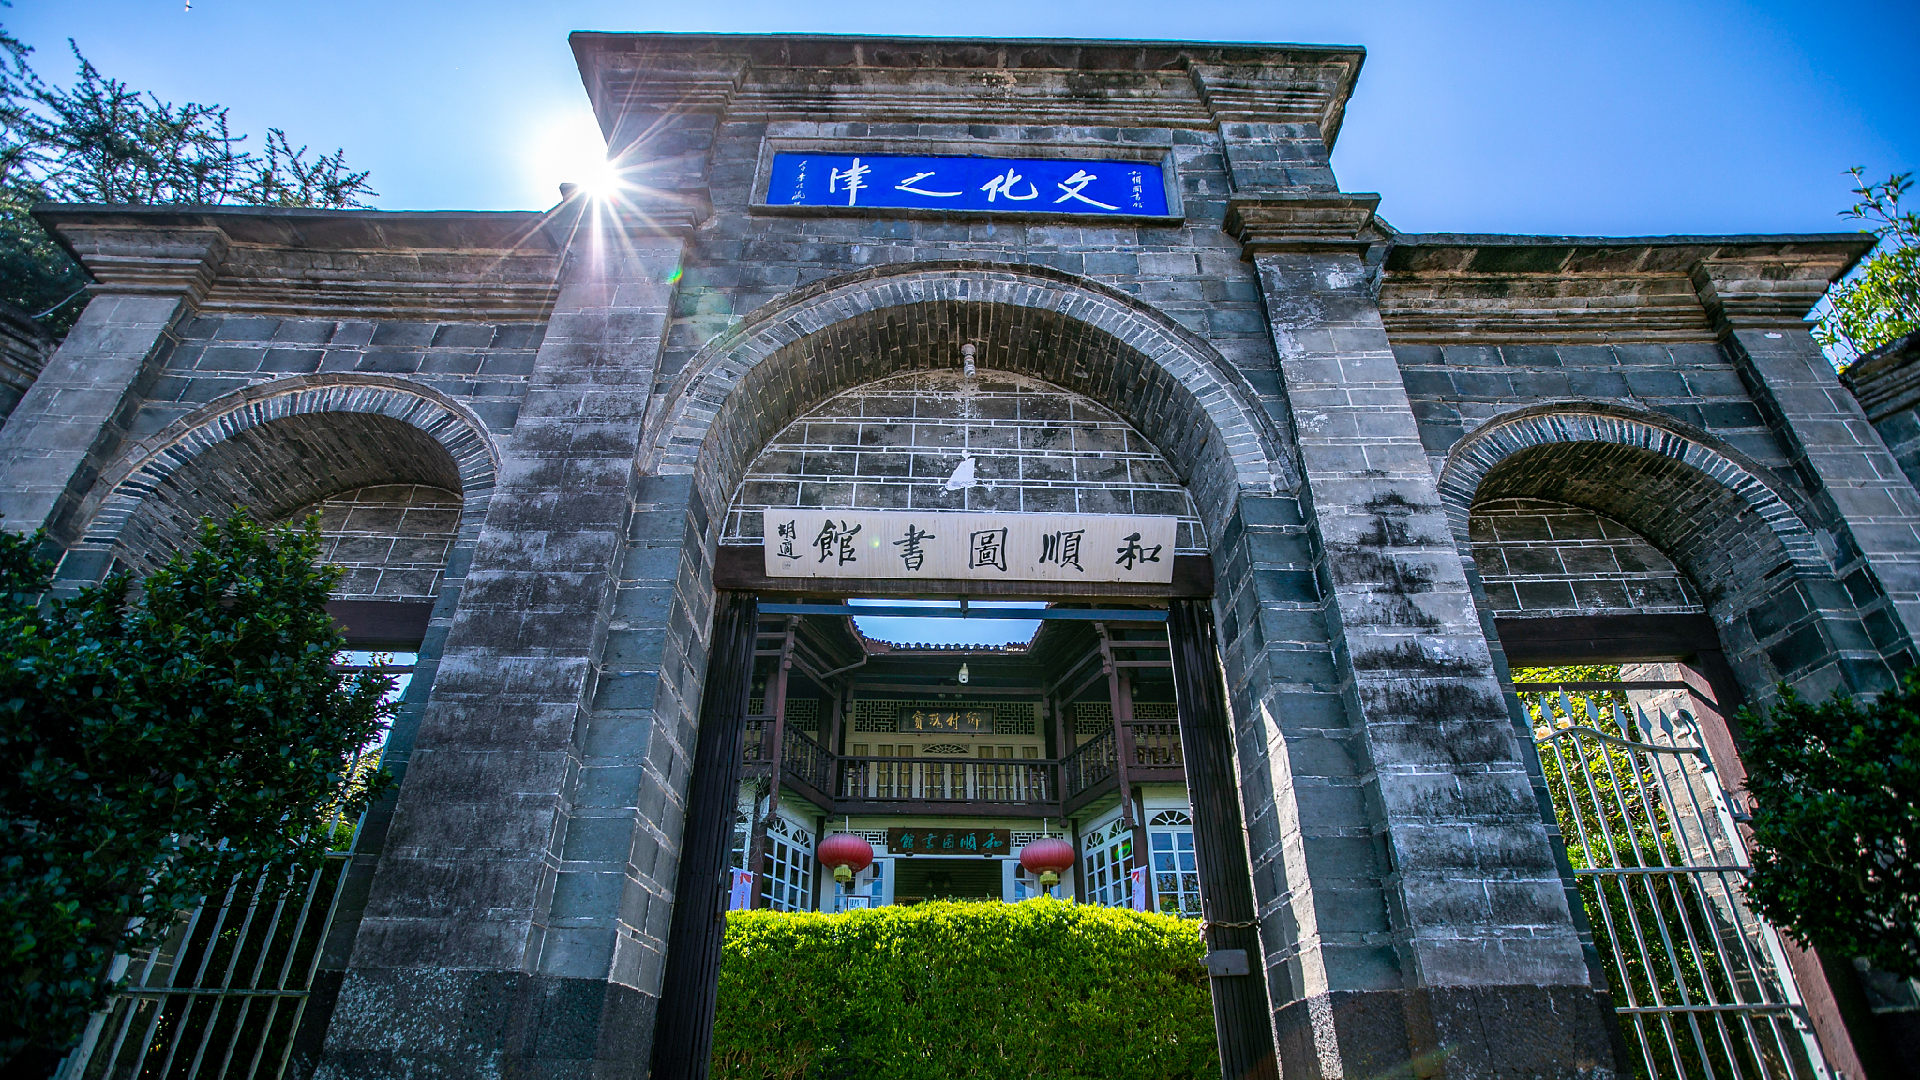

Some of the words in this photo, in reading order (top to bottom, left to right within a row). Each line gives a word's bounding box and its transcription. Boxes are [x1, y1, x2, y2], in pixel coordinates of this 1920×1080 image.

[830, 158, 1121, 209] 文化之津
[812, 519, 1161, 571] 和順圖書館
